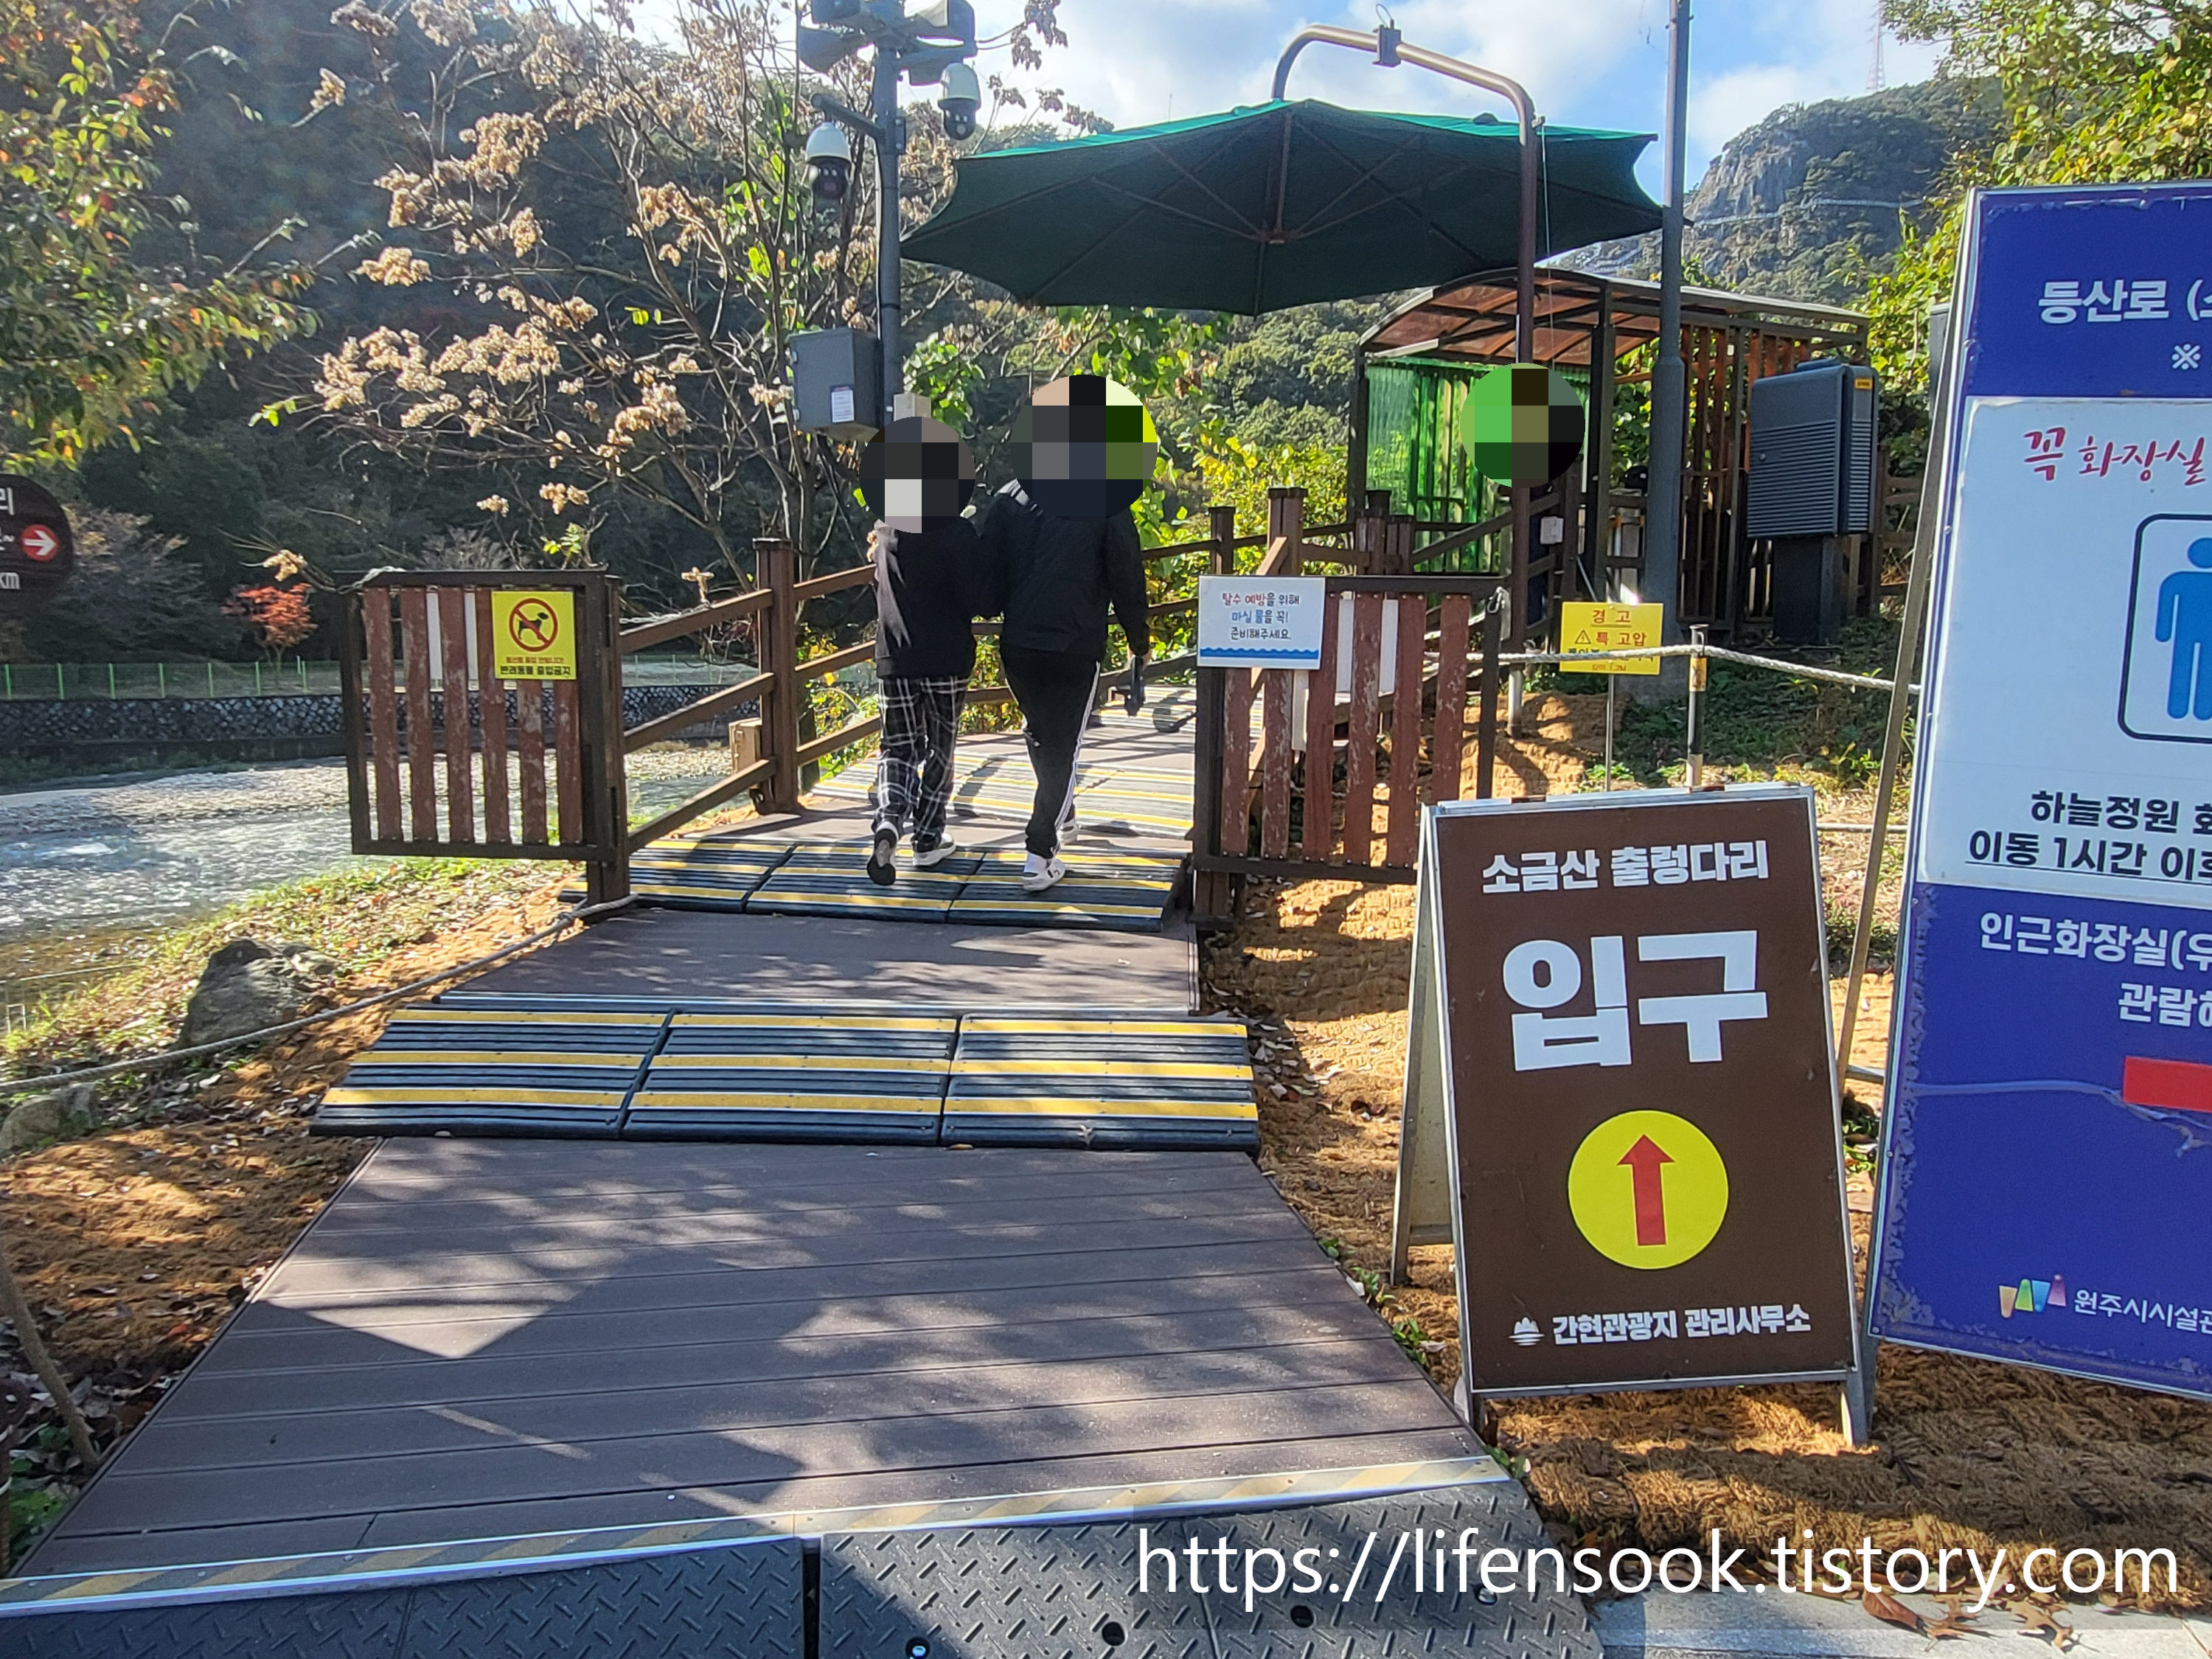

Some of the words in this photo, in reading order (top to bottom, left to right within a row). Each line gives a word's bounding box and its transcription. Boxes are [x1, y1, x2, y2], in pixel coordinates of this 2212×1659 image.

[2038, 279, 2169, 324] 등산로
[2023, 427, 2066, 481] 꼭
[2078, 436, 2206, 486] 화장실
[1222, 593, 1242, 606] 탈수
[1245, 592, 1276, 607] 예방을
[1278, 594, 1299, 605] 위해
[1231, 610, 1252, 624] 마실
[1255, 610, 1273, 624] 물을
[2031, 790, 2180, 834] 하늘정원
[1482, 849, 1600, 894] 소금산
[1610, 840, 1769, 887] 출렁다리
[1969, 830, 2039, 866] 이동
[2053, 836, 2147, 876] 1시간
[1503, 930, 1768, 1071] 입구
[1552, 1310, 1678, 1345] 간현관광지
[1684, 1304, 1812, 1338] 관리사무소
